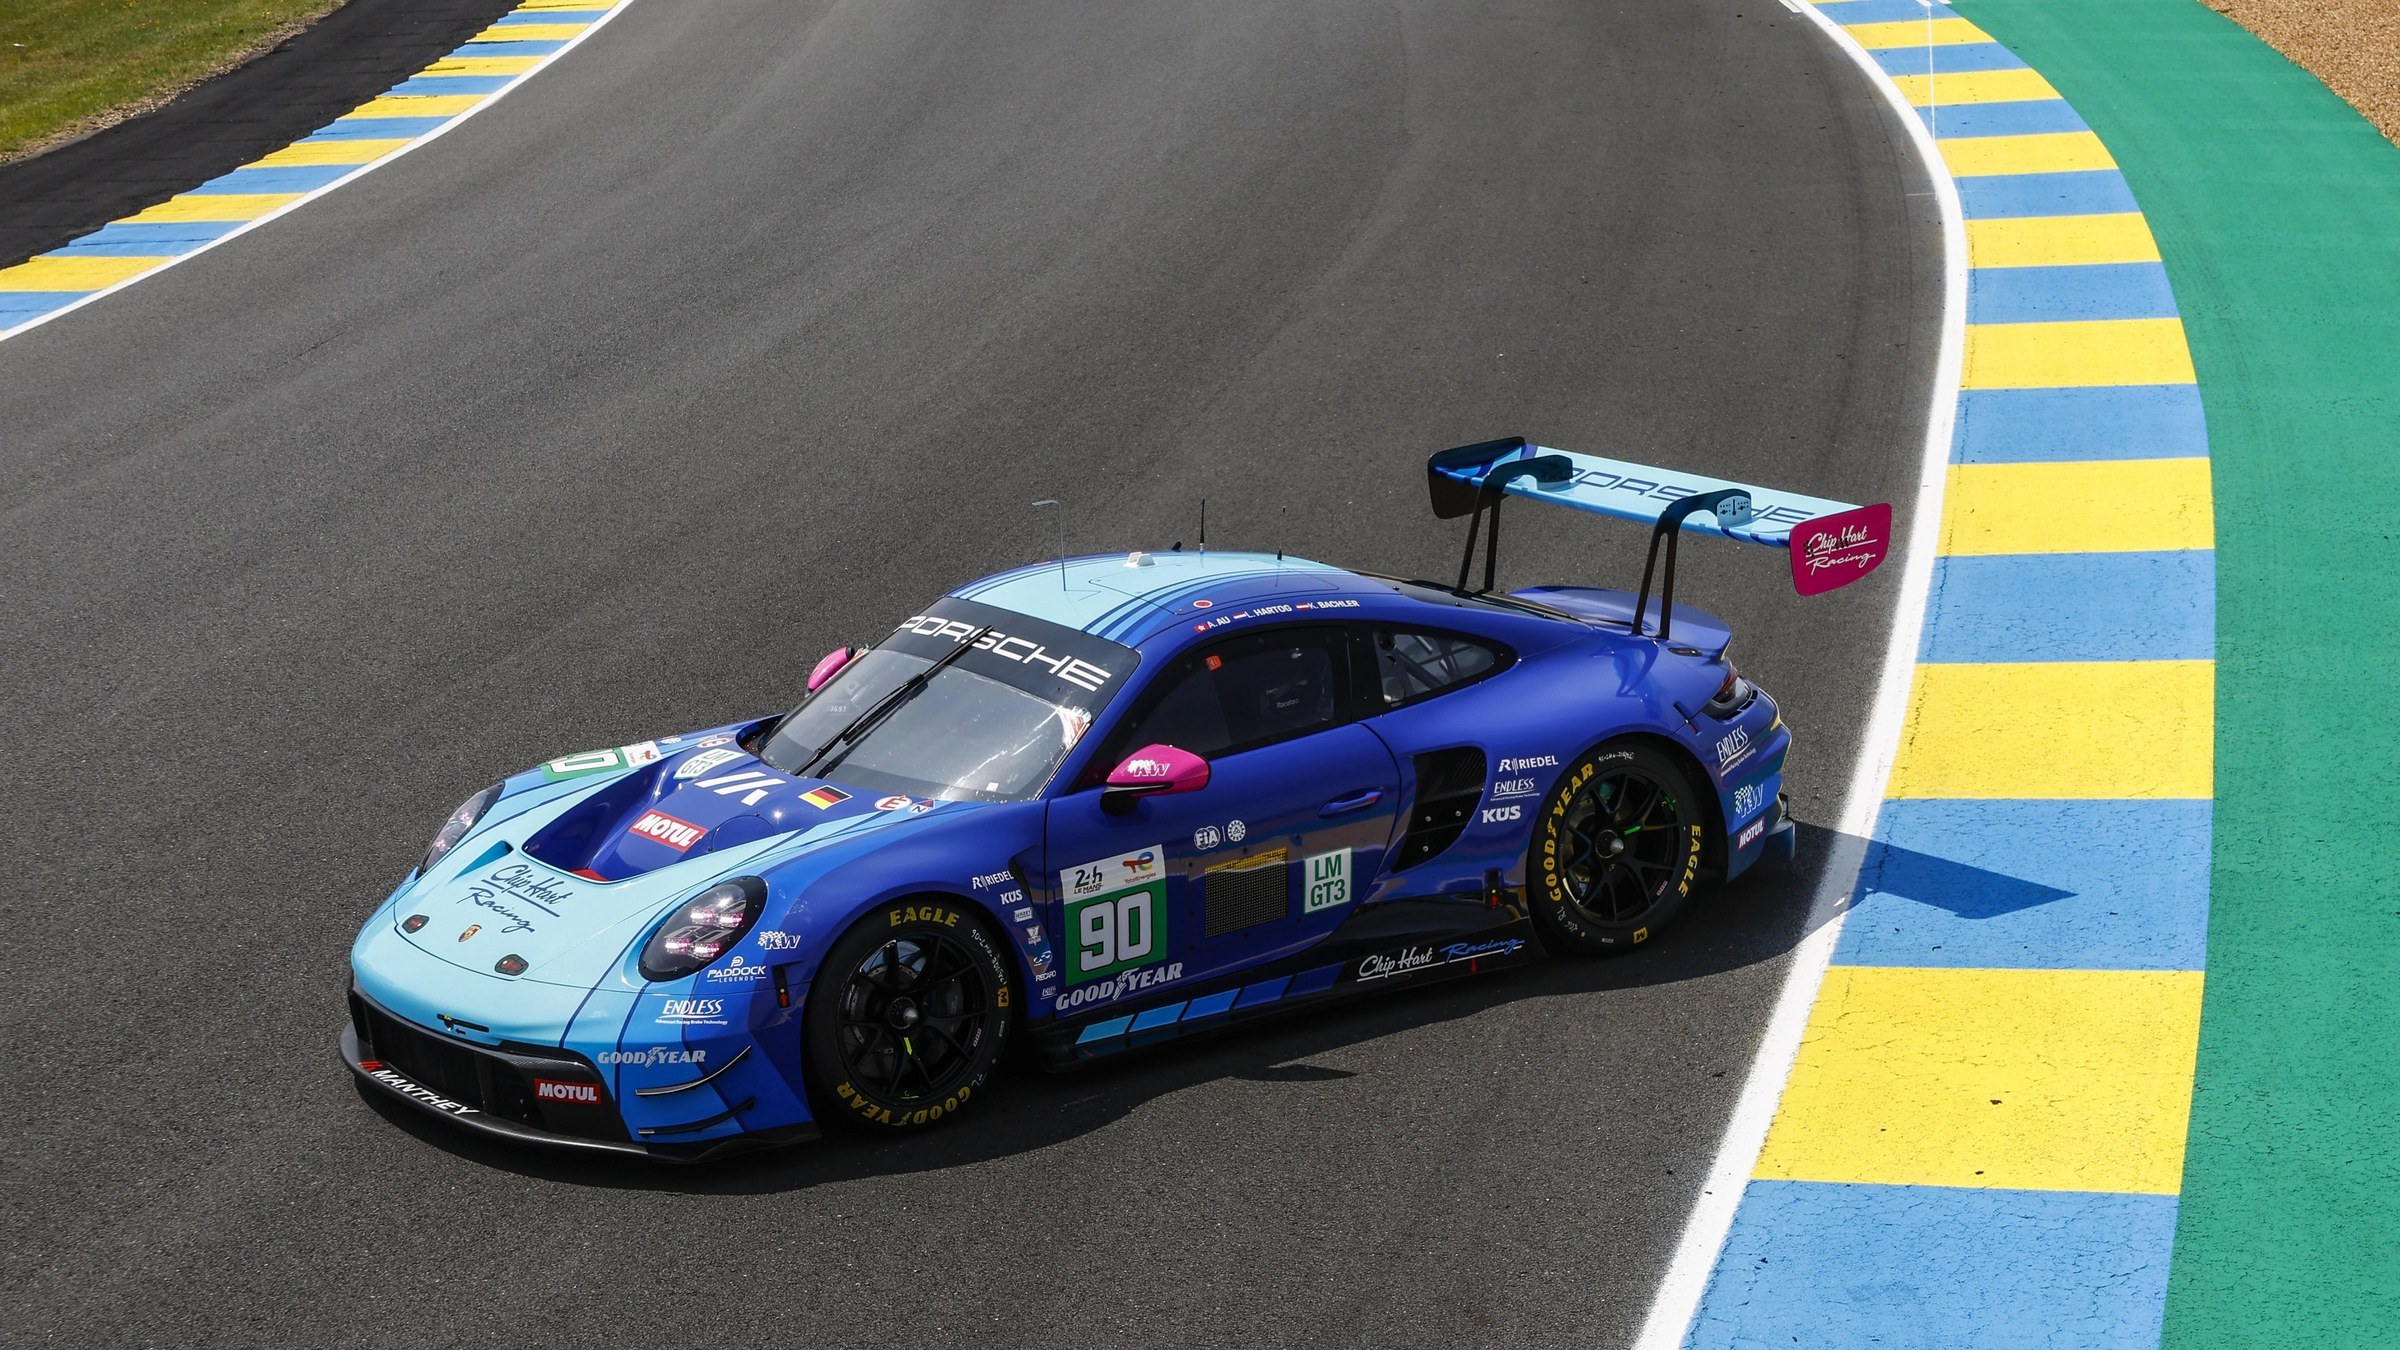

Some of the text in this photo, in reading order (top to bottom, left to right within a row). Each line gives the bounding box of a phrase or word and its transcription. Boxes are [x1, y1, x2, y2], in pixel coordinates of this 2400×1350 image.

[1806, 524, 1868, 554] Chip Hart
[1805, 552, 1876, 576] Racing
[1255, 604, 1293, 617] HARTOG
[1318, 600, 1360, 609] BACHLER
[893, 615, 1112, 692] PORSCHE
[1716, 725, 1749, 762] ENDLESS
[1518, 755, 1559, 770] RIEDEL
[1494, 777, 1534, 794] ENDLESS
[1481, 805, 1521, 824] KÜS
[634, 813, 701, 848] MOTUL
[1738, 819, 1764, 849] MOTUL
[1314, 853, 1342, 882] LM
[1678, 825, 1701, 898] EAGLE
[491, 864, 574, 905] Chip Hart
[985, 870, 1014, 886] RIEDEL
[1310, 879, 1346, 906] GT3
[456, 886, 536, 934] Racing
[890, 906, 960, 928] EAGLE
[1080, 891, 1152, 971] 90
[707, 966, 766, 978] PADDOCK
[1359, 938, 1525, 978] Chip Hart Racing
[1056, 962, 1183, 1011] GOODYEAR
[662, 999, 725, 1015] ENDLESS
[597, 1047, 706, 1069] GOODYEAR
[371, 1068, 480, 1115] MANTHEY
[538, 1082, 598, 1101] MOTUL
